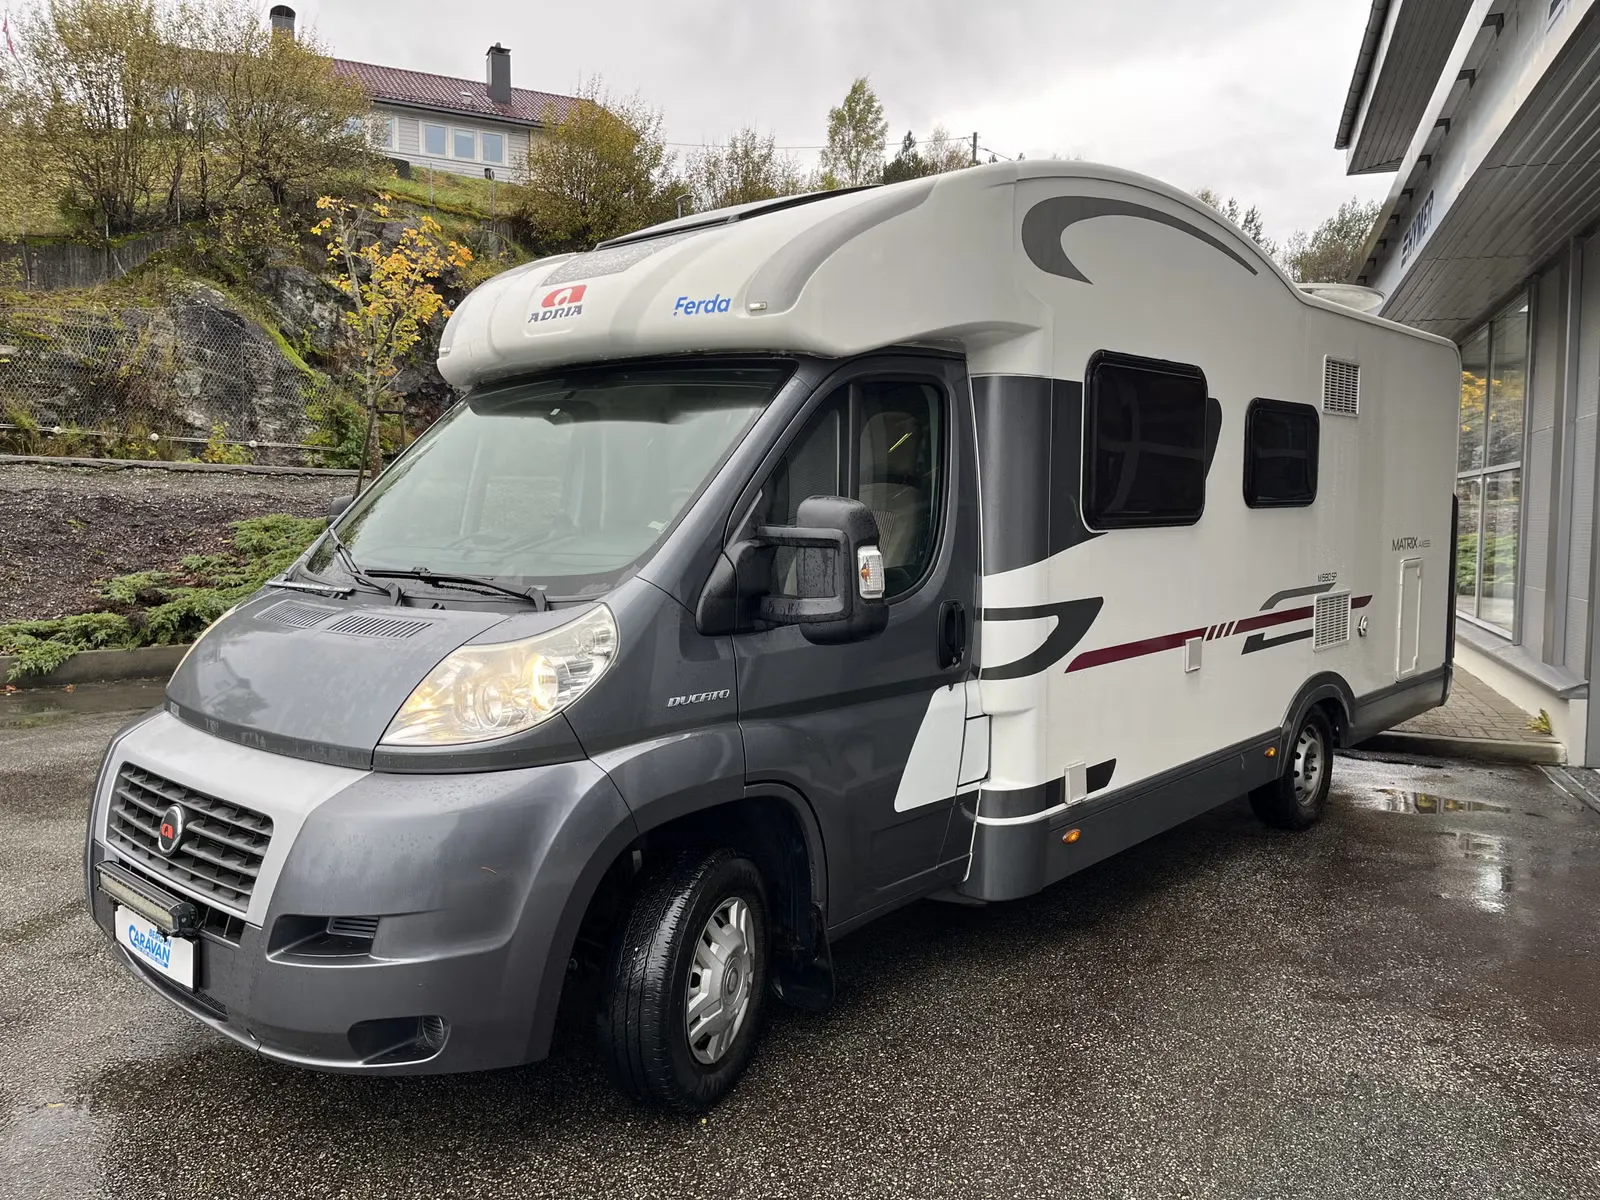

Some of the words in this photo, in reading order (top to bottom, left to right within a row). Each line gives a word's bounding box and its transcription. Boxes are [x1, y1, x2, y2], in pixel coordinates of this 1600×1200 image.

[528, 304, 583, 323] ADRIA
[673, 294, 732, 316] Ferda
[1391, 536, 1418, 551] MATRIX
[667, 689, 731, 708] DUCATO
[128, 924, 172, 963] CARAVAN
